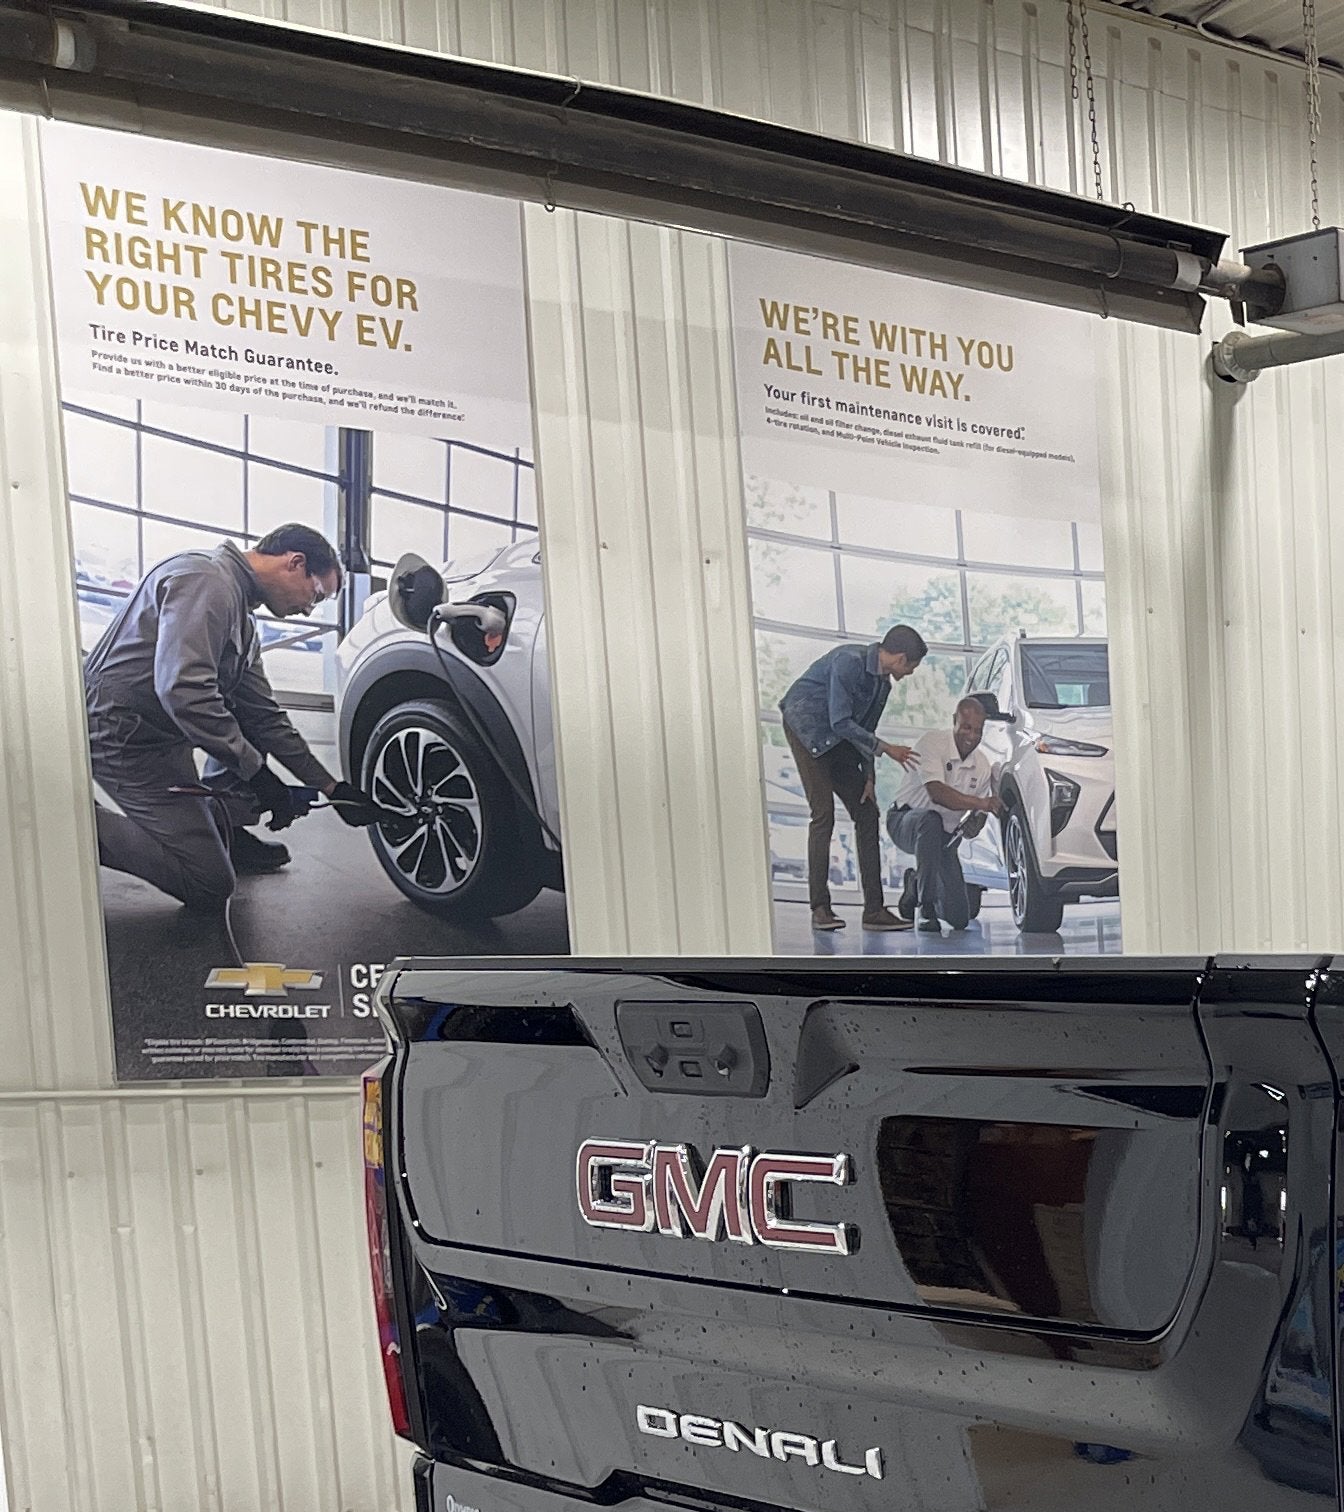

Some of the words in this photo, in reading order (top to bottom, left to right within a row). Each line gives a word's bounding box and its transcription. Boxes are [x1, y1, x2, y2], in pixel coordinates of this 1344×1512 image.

[80, 182, 148, 226] WE
[162, 197, 283, 249] KNOW
[296, 220, 371, 263] THE
[84, 226, 208, 279] RIGHT
[221, 250, 334, 299] TIRES
[347, 270, 419, 312] FOR
[84, 269, 198, 322] YOUR
[211, 293, 342, 341] CHEVY
[357, 313, 412, 351] EV.
[759, 298, 861, 346] WE'RE
[869, 320, 948, 362] WITH
[956, 336, 1014, 373] YOU
[89, 323, 126, 344] Tire
[132, 330, 179, 352] Price
[185, 339, 238, 362] Match
[245, 348, 339, 376] Guarantee.
[91, 349, 128, 363] Provide
[131, 356, 142, 366] us
[144, 358, 166, 370] with
[176, 362, 206, 376] better
[208, 369, 242, 381] eligible
[244, 374, 267, 385] price
[270, 377, 279, 386] at
[281, 379, 297, 389] the
[298, 381, 319, 392] time
[321, 383, 331, 393] of
[333, 386, 377, 401] purchase,
[378, 392, 394, 401] and
[396, 395, 416, 405] we'll
[418, 397, 446, 409] match
[763, 337, 823, 376] ALL
[831, 350, 892, 389] THE
[900, 363, 971, 402] WAY.
[92, 361, 113, 374] Find
[124, 365, 154, 380] better
[157, 373, 181, 384] price
[183, 375, 213, 389] within
[215, 382, 227, 391] 30
[229, 383, 251, 396] days
[253, 386, 263, 396] of
[264, 388, 280, 399] the
[282, 390, 327, 406] purchase,
[328, 397, 345, 407] and
[347, 400, 367, 410] we'll
[369, 402, 399, 414] refund
[400, 406, 415, 416] the
[764, 383, 797, 403] Your
[800, 390, 832, 410] first
[836, 398, 922, 426] maintenance
[925, 413, 953, 431] visit
[956, 416, 968, 432] is
[204, 1003, 331, 1019] CHEVROLET
[576, 1137, 857, 1256] GMC
[636, 1403, 884, 1481] DENALI
